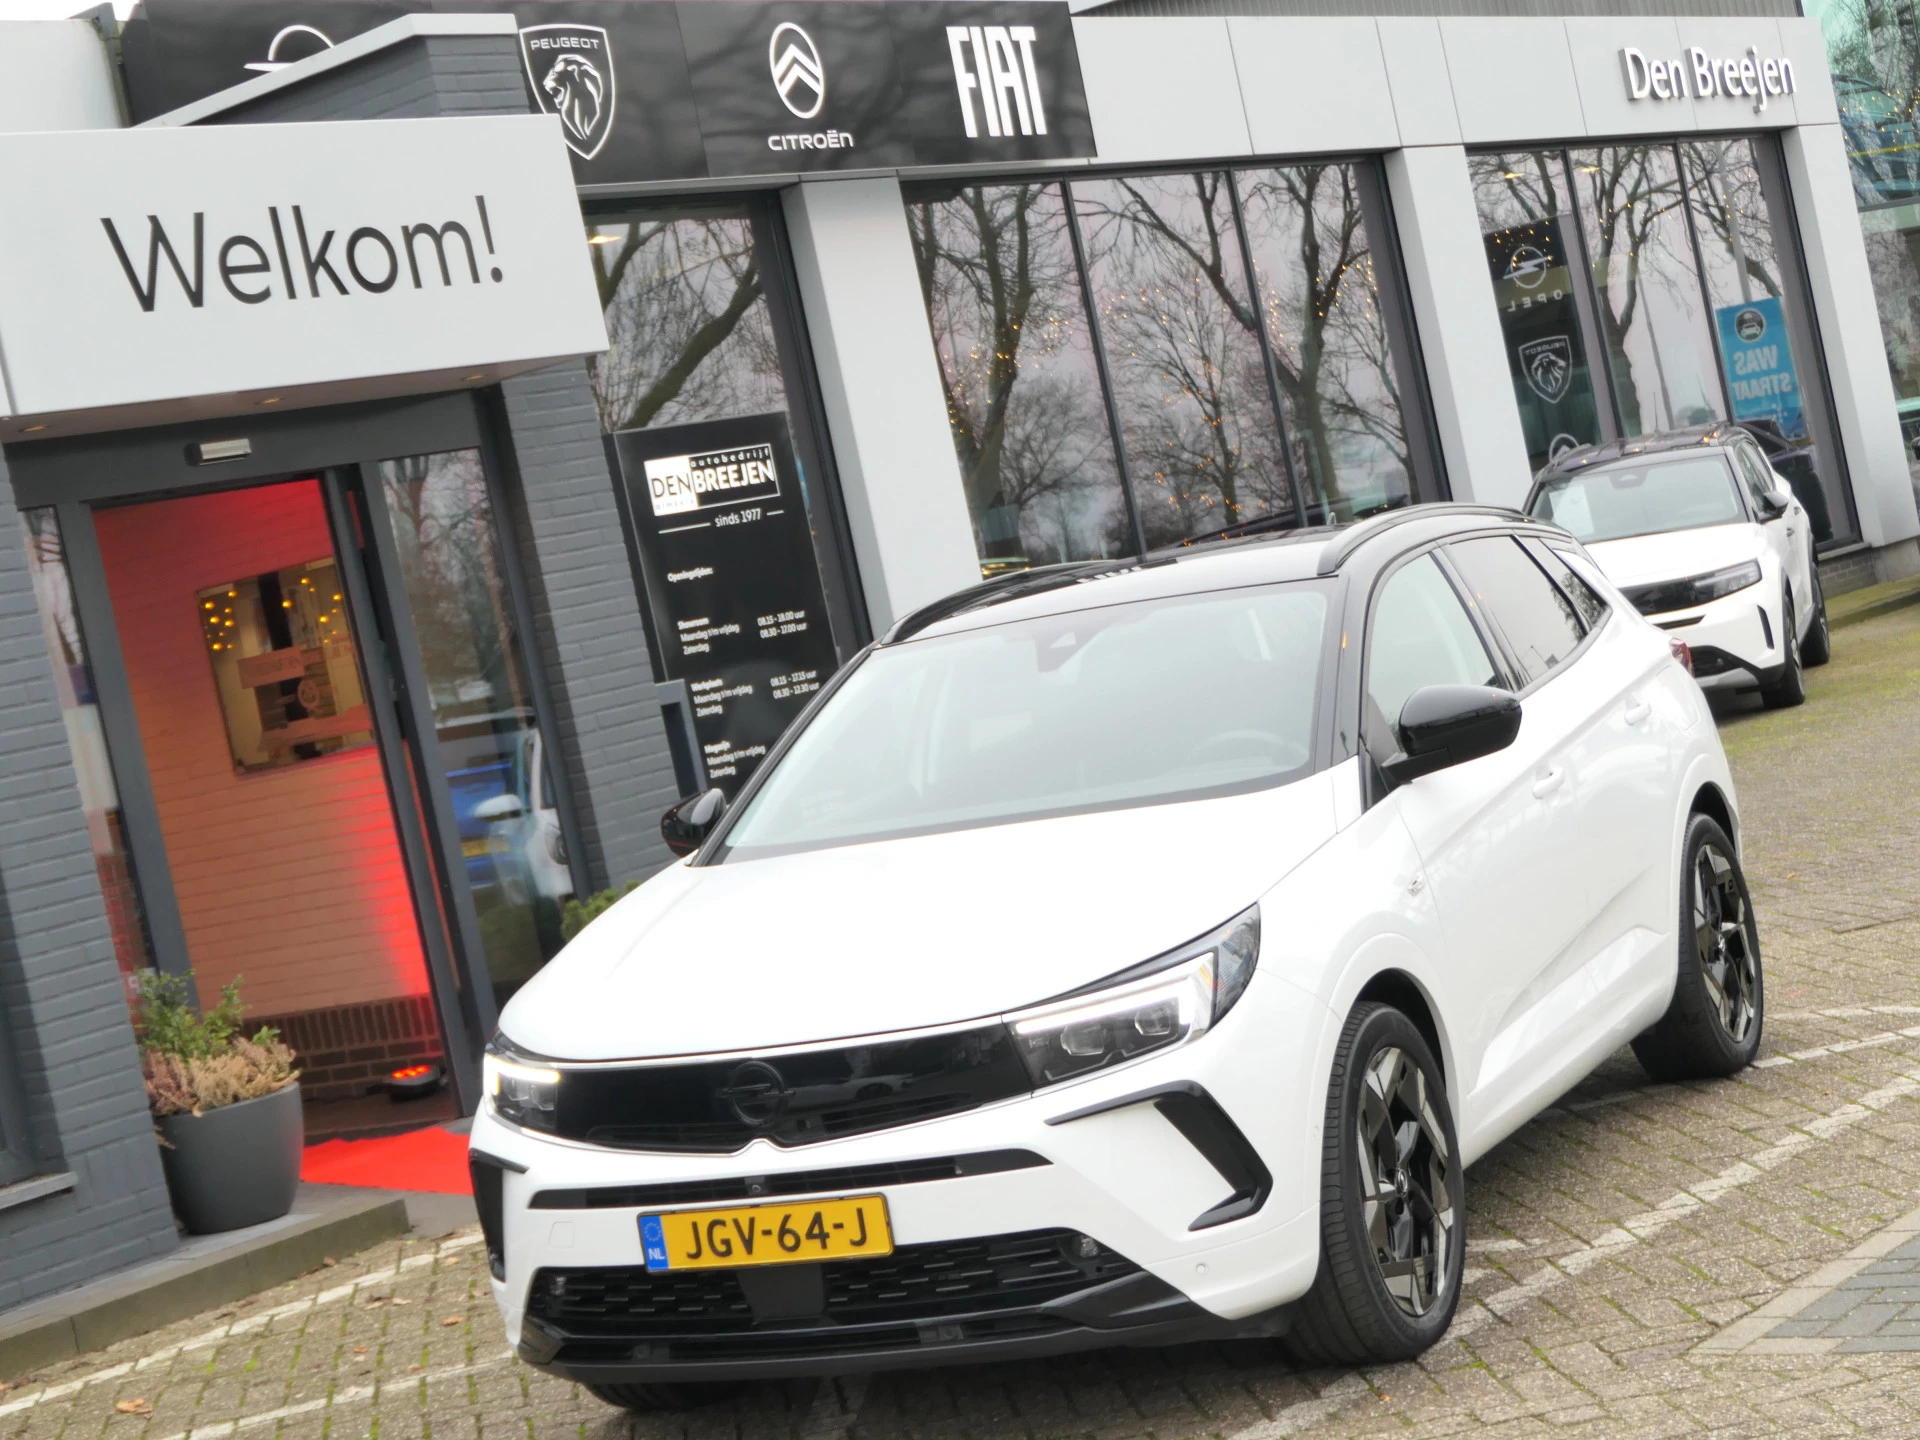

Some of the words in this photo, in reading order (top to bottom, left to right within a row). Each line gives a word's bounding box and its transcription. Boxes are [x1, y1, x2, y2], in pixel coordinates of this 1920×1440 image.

[529, 37, 600, 51] PEUGEOT
[945, 25, 1047, 138] FIAT
[1618, 46, 1689, 100] Den
[1685, 44, 1797, 113] Breejen
[100, 194, 504, 313] Welkom!
[690, 447, 771, 468] autobedrijf
[651, 472, 693, 498] DEN
[691, 459, 775, 494] BREEJEN
[714, 513, 740, 528] sinds
[740, 507, 762, 523] 1977
[794, 610, 805, 619] uur
[796, 622, 807, 631] uur
[806, 670, 817, 679] uur
[809, 682, 820, 691] uur
[685, 1207, 868, 1260] JGV-64-J
[648, 1247, 665, 1260] NL
